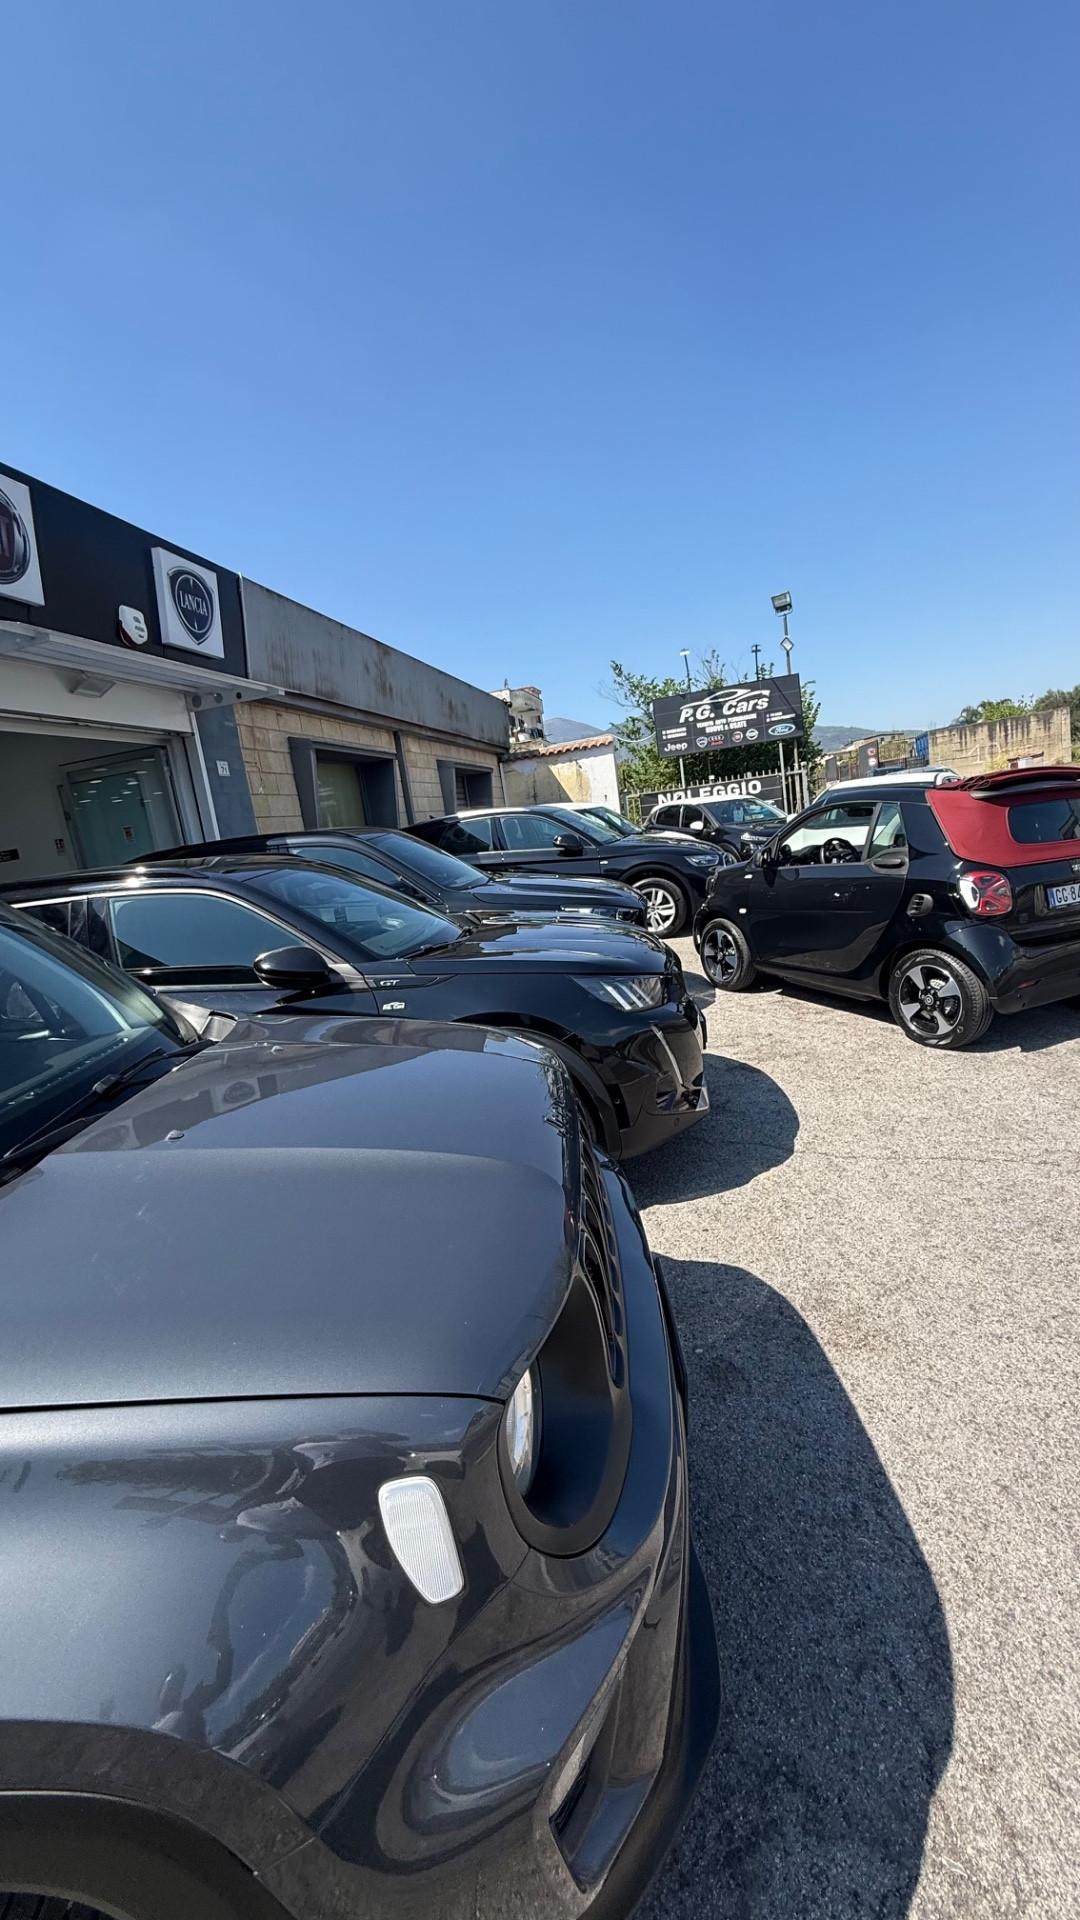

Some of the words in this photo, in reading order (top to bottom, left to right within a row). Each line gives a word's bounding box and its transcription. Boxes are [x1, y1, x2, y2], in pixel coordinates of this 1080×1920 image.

[179, 590, 208, 616] LANCIA
[679, 704, 715, 723] P.G.
[723, 698, 769, 715] Cars
[730, 720, 747, 730] USATE
[664, 742, 688, 752] Jeep
[657, 780, 762, 805] NOLEGGIO
[1056, 888, 1068, 903] GG
